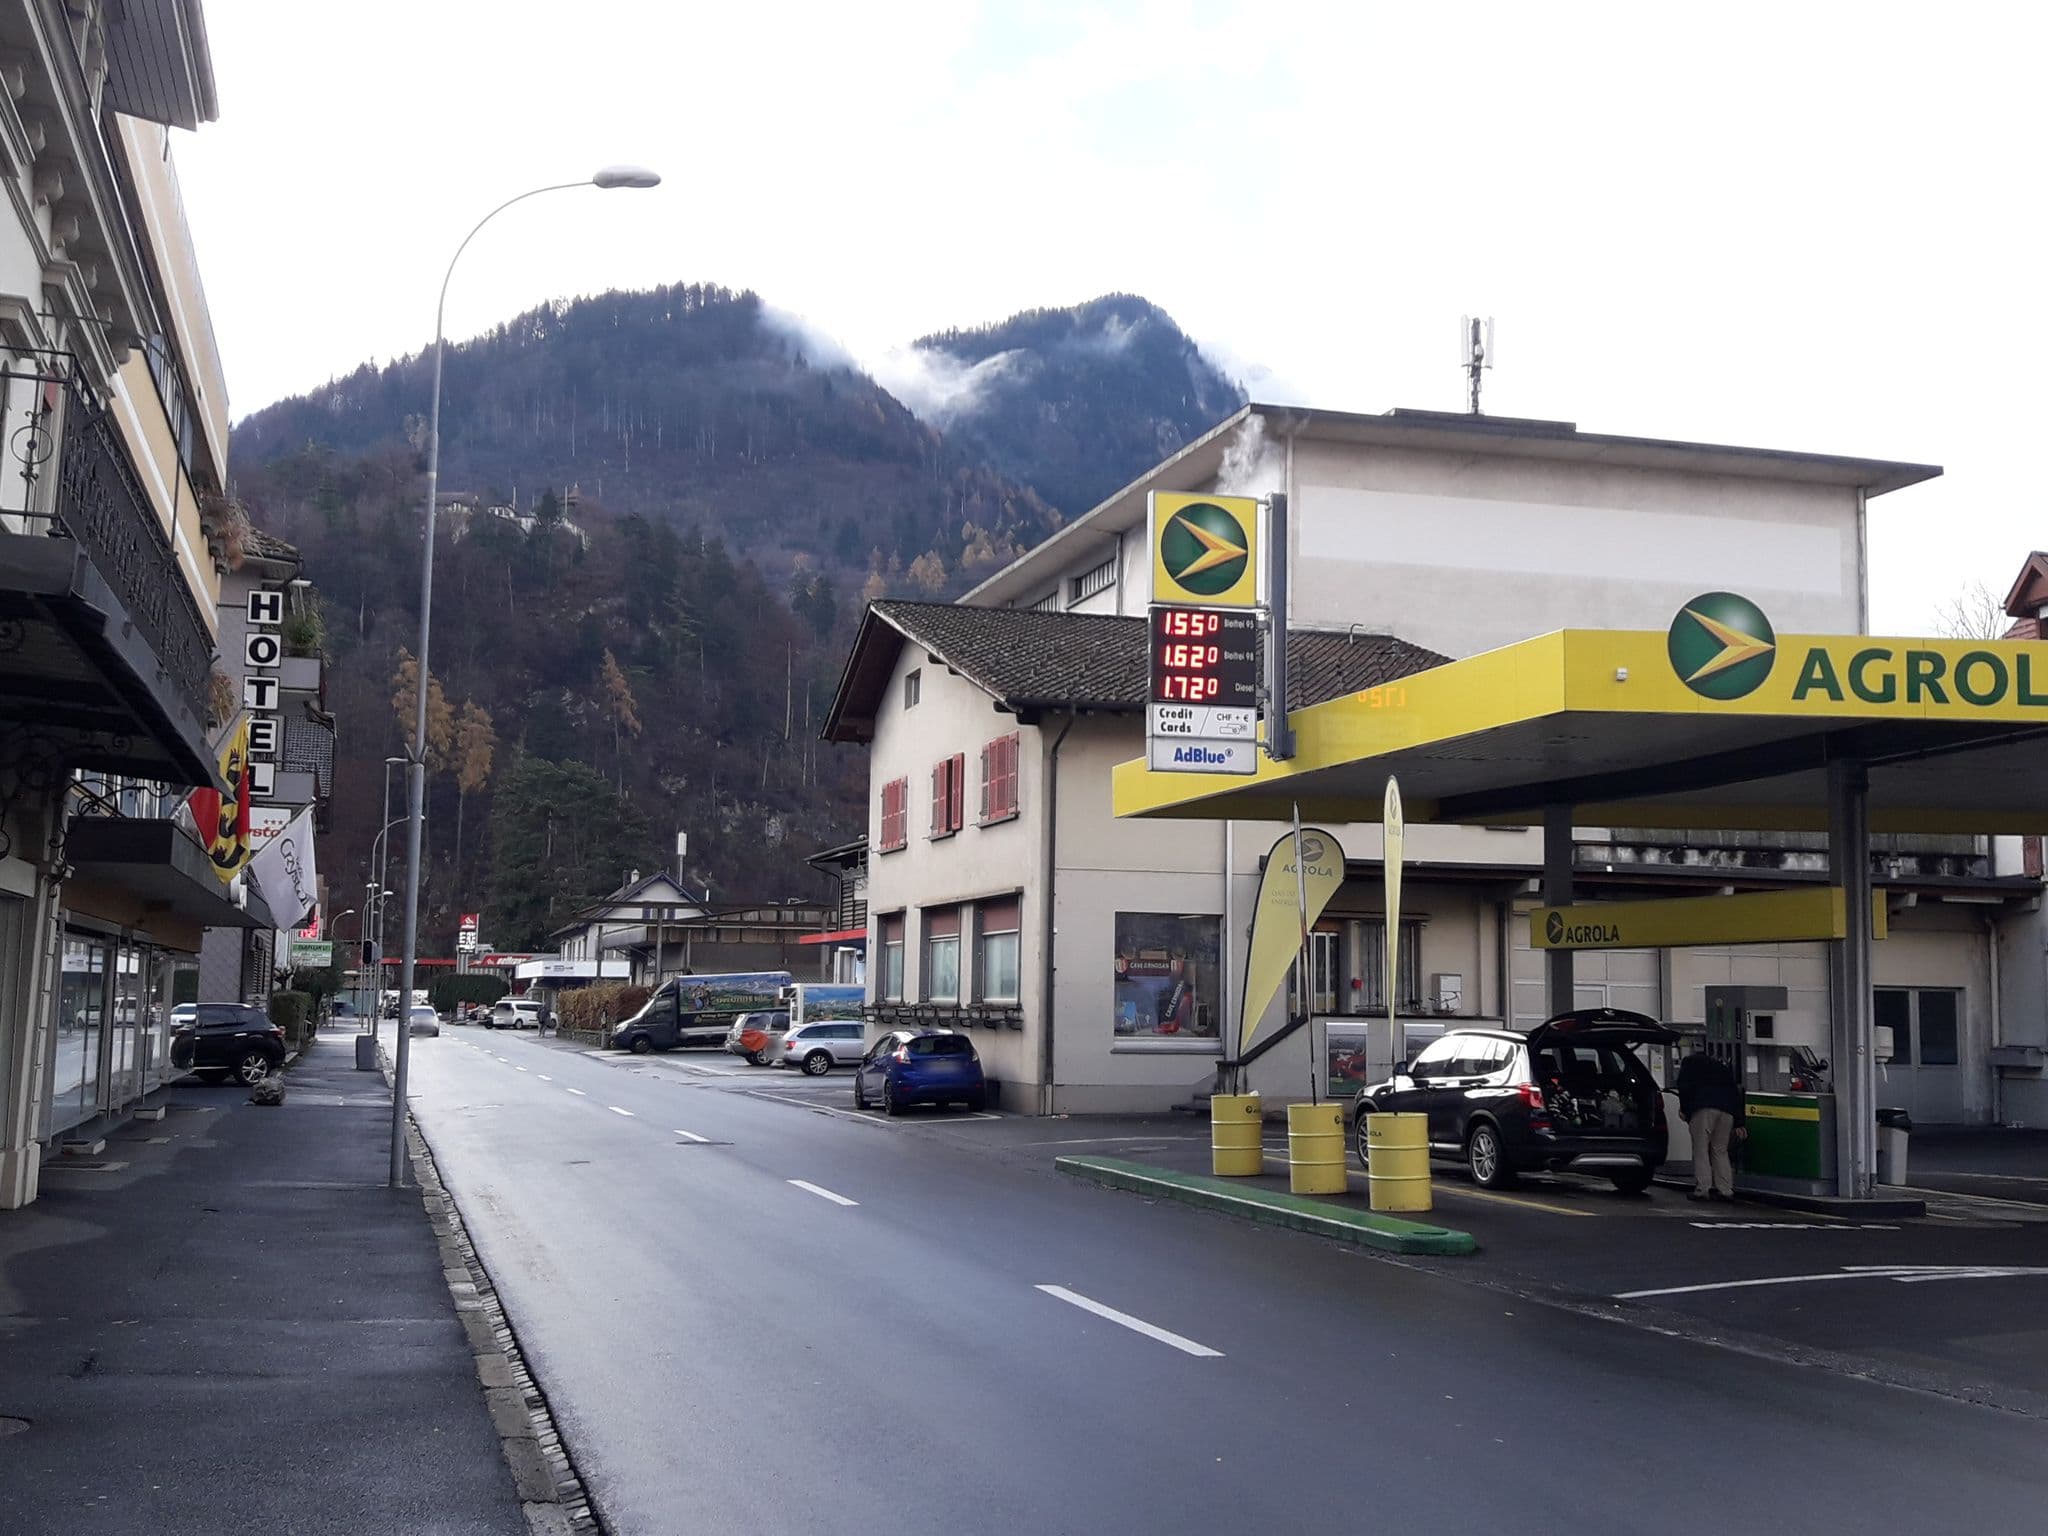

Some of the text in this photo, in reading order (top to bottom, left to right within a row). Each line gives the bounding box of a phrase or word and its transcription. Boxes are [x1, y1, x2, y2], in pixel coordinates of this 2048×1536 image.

[1791, 648, 2048, 706] AGROL
[250, 593, 281, 793] HOTEL
[1235, 683, 1254, 692] Diesel
[1160, 708, 1193, 719] Credit
[1217, 713, 1232, 721] CHF
[1161, 722, 1191, 733] Cards
[1566, 925, 1620, 943] AGROLA
